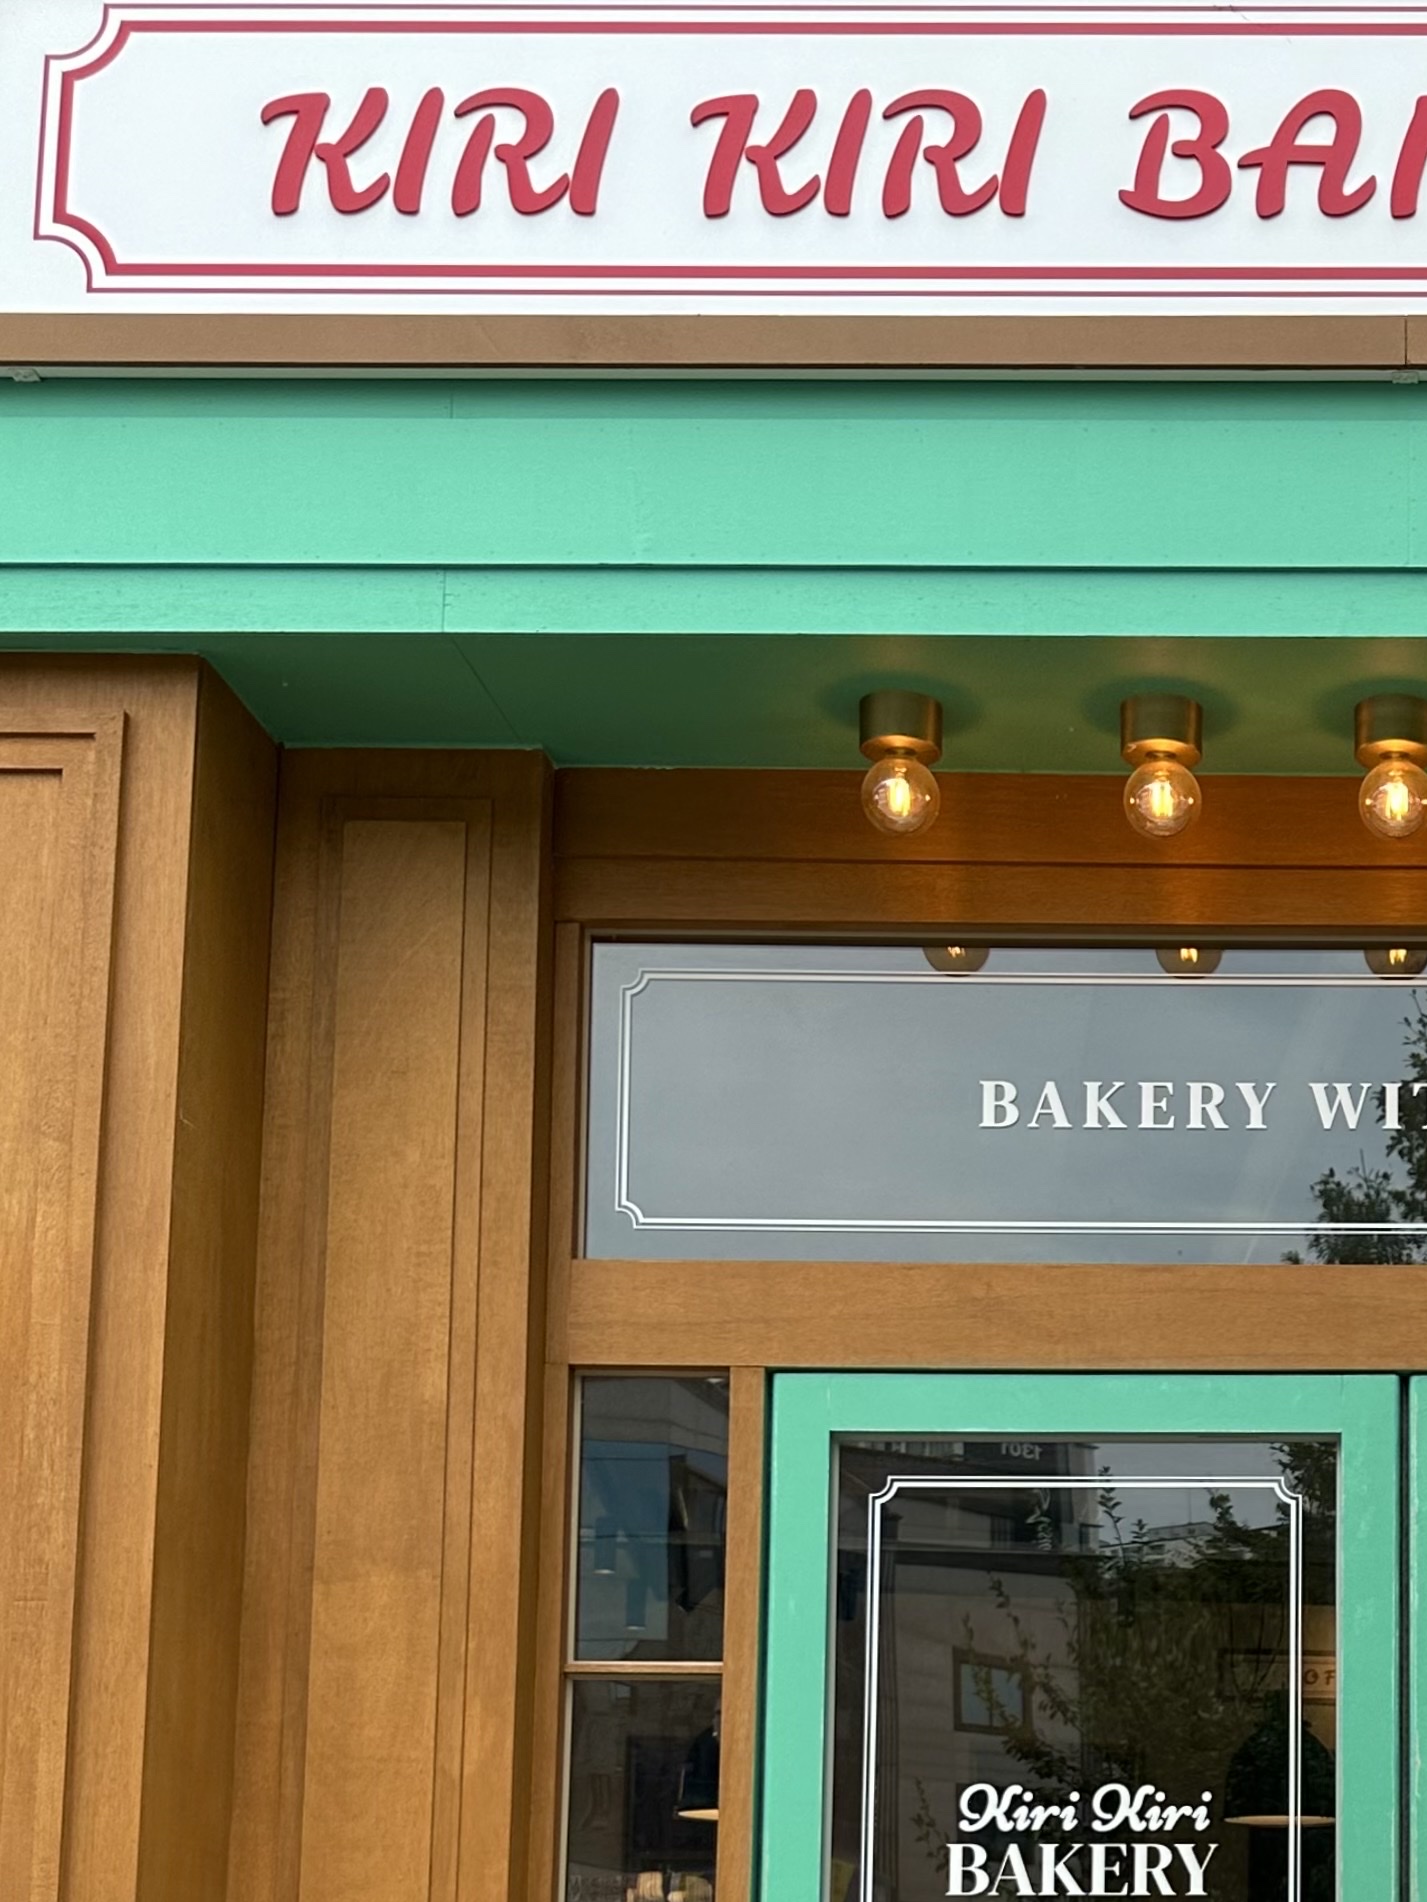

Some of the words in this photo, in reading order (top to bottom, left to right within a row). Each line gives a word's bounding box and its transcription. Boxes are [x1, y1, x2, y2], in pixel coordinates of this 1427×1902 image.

[260, 86, 620, 217] KIRI
[688, 86, 1048, 217] KIRI
[978, 1079, 1278, 1130] BAKERY
[958, 1782, 1081, 1833] Kiri
[1090, 1782, 1213, 1833] Kiri
[944, 1843, 1220, 1897] BAKERY
